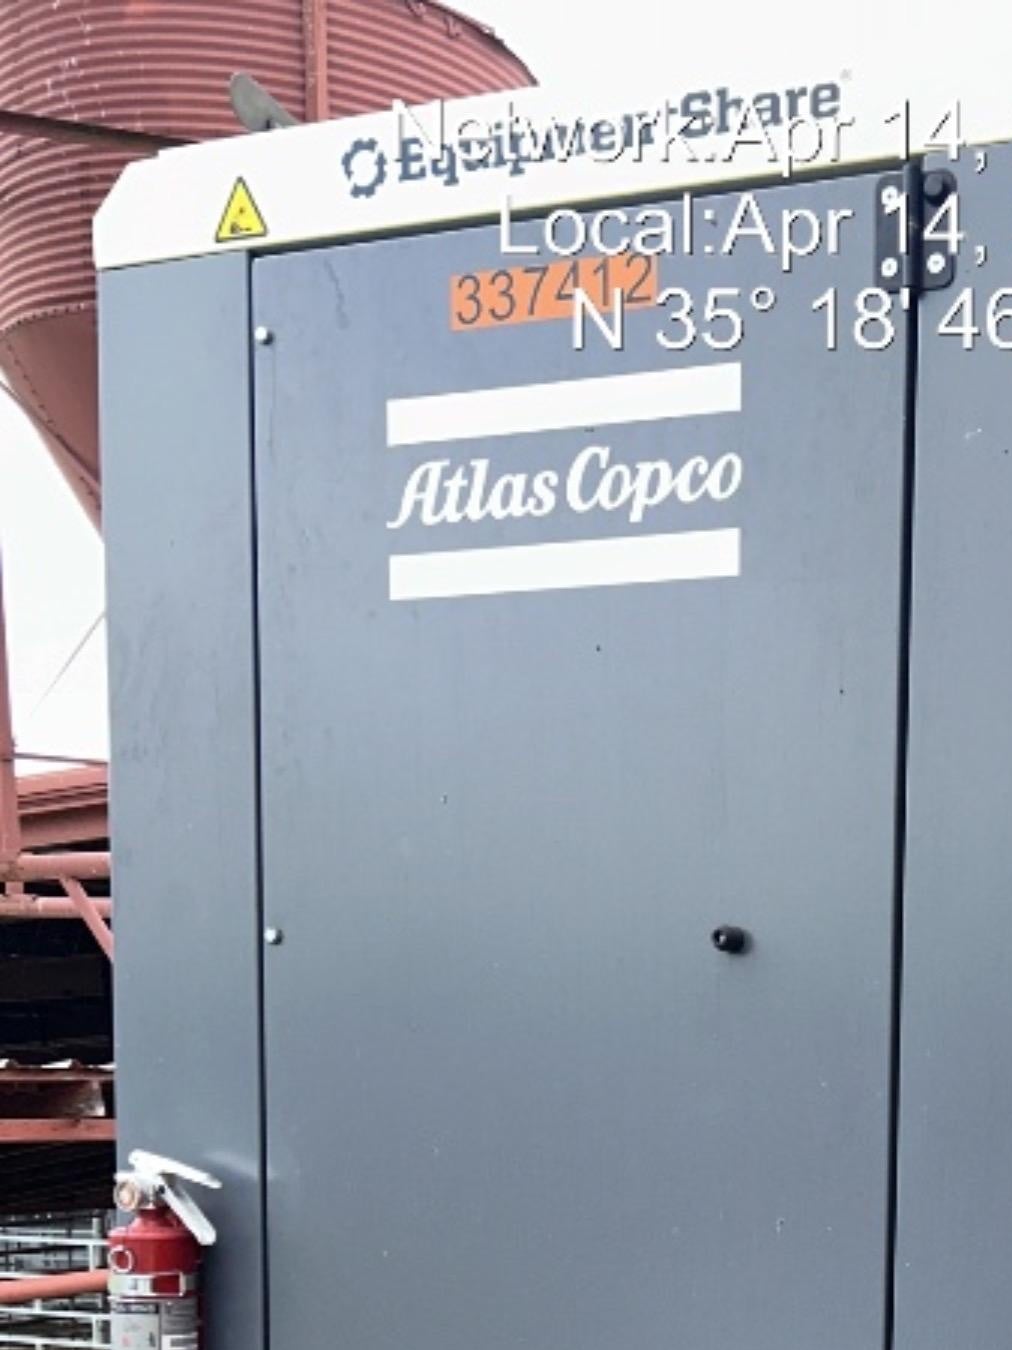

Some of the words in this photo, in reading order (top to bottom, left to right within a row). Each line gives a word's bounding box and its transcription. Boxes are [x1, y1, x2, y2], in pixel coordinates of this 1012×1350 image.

[398, 80, 841, 187] EquipmenShare
[455, 252, 655, 327] 337412
[386, 457, 560, 530] Atlas
[565, 445, 743, 523] Copco
